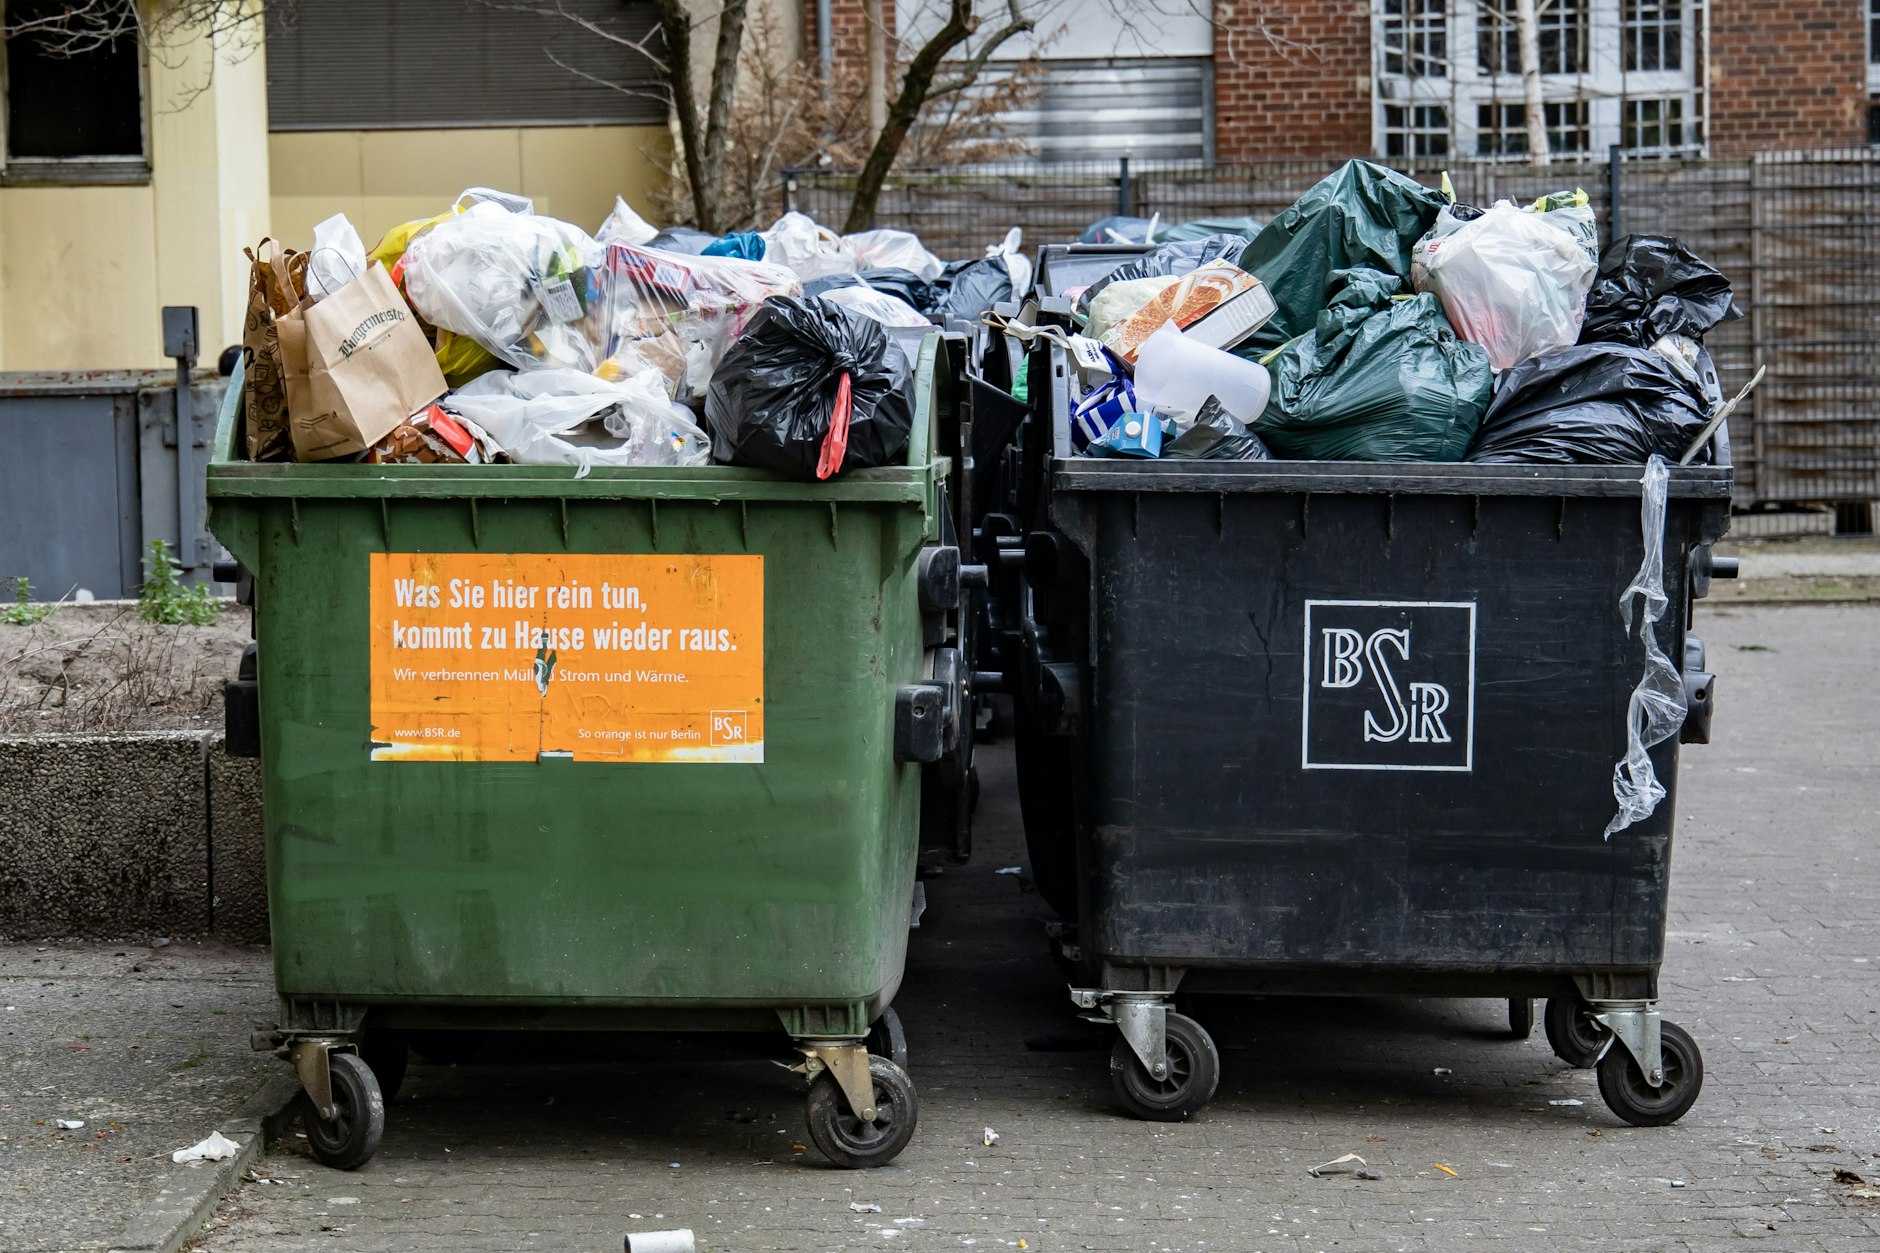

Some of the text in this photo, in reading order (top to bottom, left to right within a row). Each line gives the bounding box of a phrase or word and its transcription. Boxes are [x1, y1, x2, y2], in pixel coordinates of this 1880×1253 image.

[339, 308, 405, 362] Burgermeister
[394, 578, 647, 613] Was Sie hier rein tun,
[393, 619, 737, 652] kommt zu Hause wieder raus.
[393, 667, 416, 680] Wir
[421, 668, 499, 681] verbrennen
[504, 668, 534, 681] Müll
[560, 669, 600, 682] Strom
[605, 669, 632, 682] und
[636, 670, 689, 683] Wärme.
[1321, 628, 1452, 743] BSR
[394, 727, 461, 738] www.BSR.de
[578, 728, 701, 742] So orange ist nur Berlin
[714, 717, 743, 740] BSR
